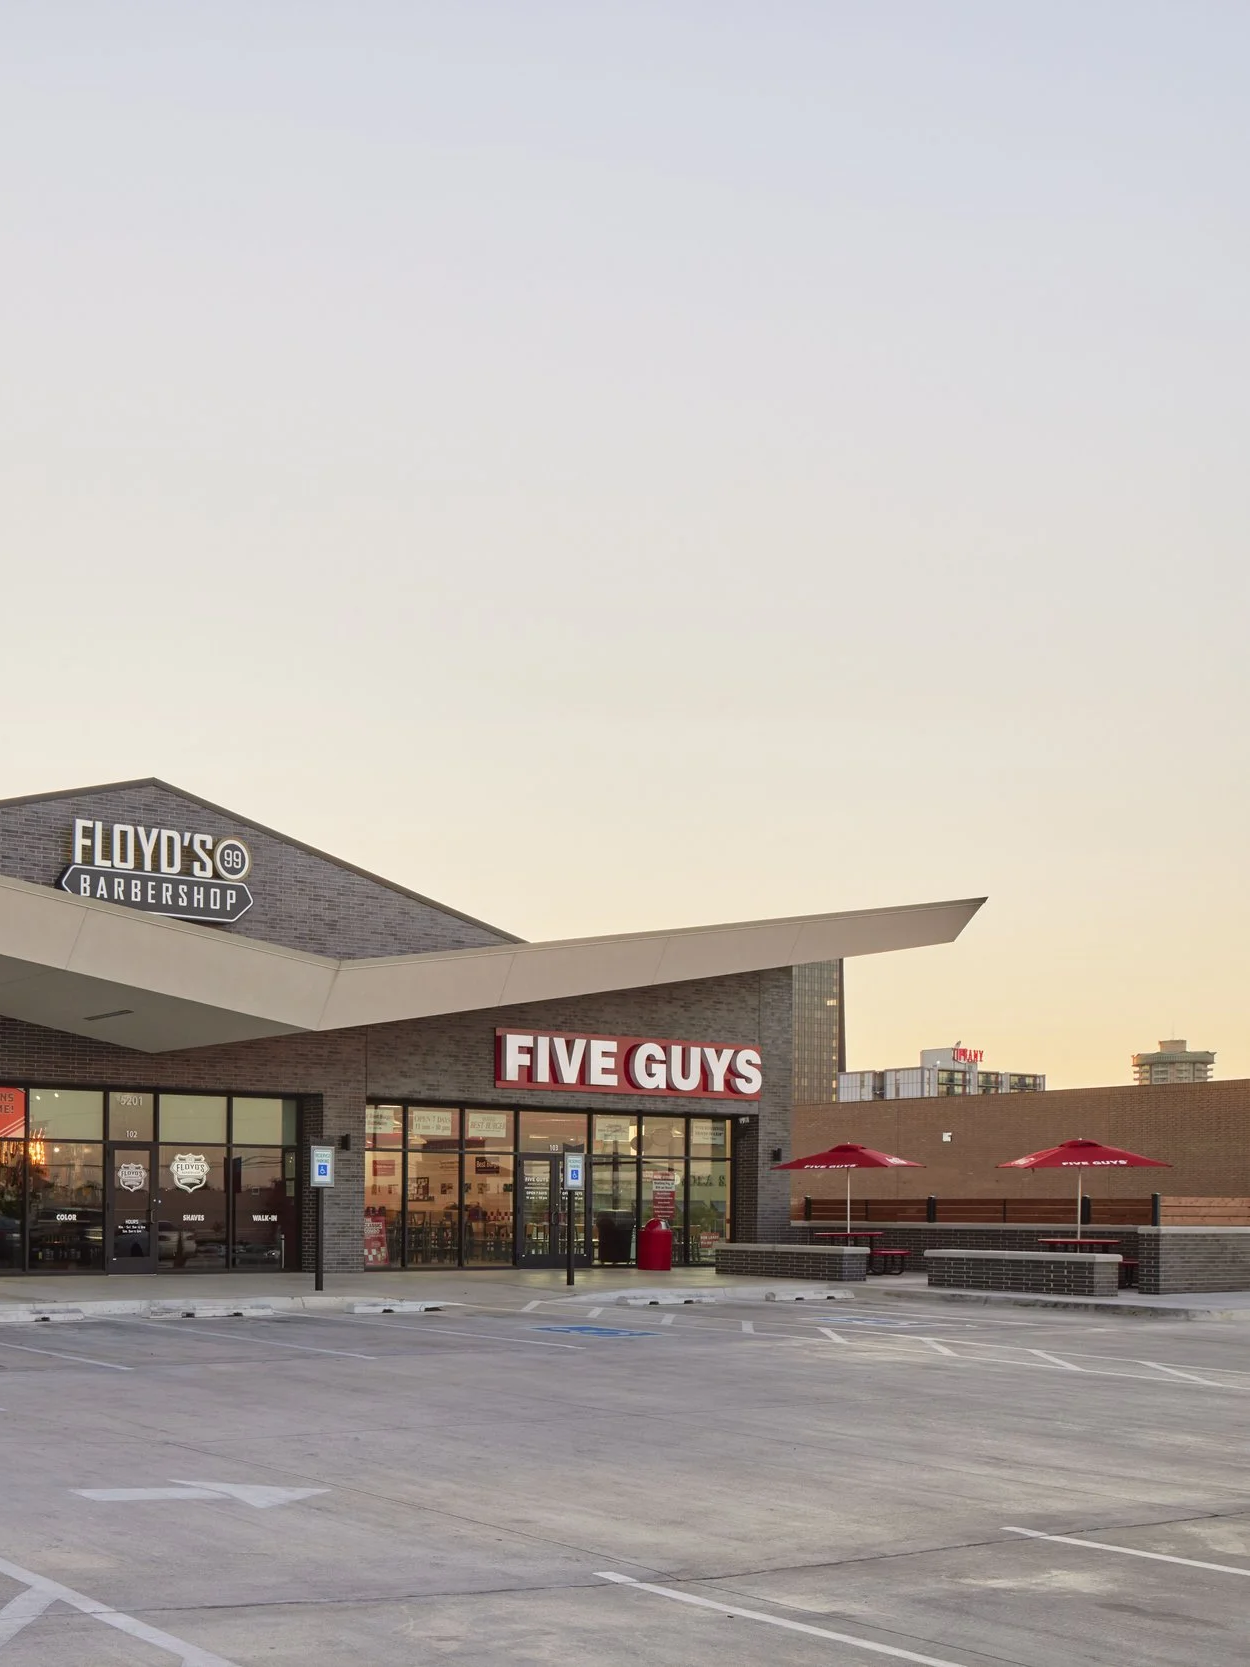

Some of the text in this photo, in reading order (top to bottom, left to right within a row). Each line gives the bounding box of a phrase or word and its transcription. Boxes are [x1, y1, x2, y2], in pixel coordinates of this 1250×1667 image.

[74, 818, 213, 878] FLOYD'S
[224, 849, 242, 869] 99
[80, 874, 237, 911] BARBERSHOP
[504, 1034, 763, 1095] FIVE GUYS
[120, 1096, 143, 1106] 5201
[126, 1130, 138, 1138] 102
[549, 1144, 559, 1152] 103
[252, 1214, 278, 1222] WALK-IN
